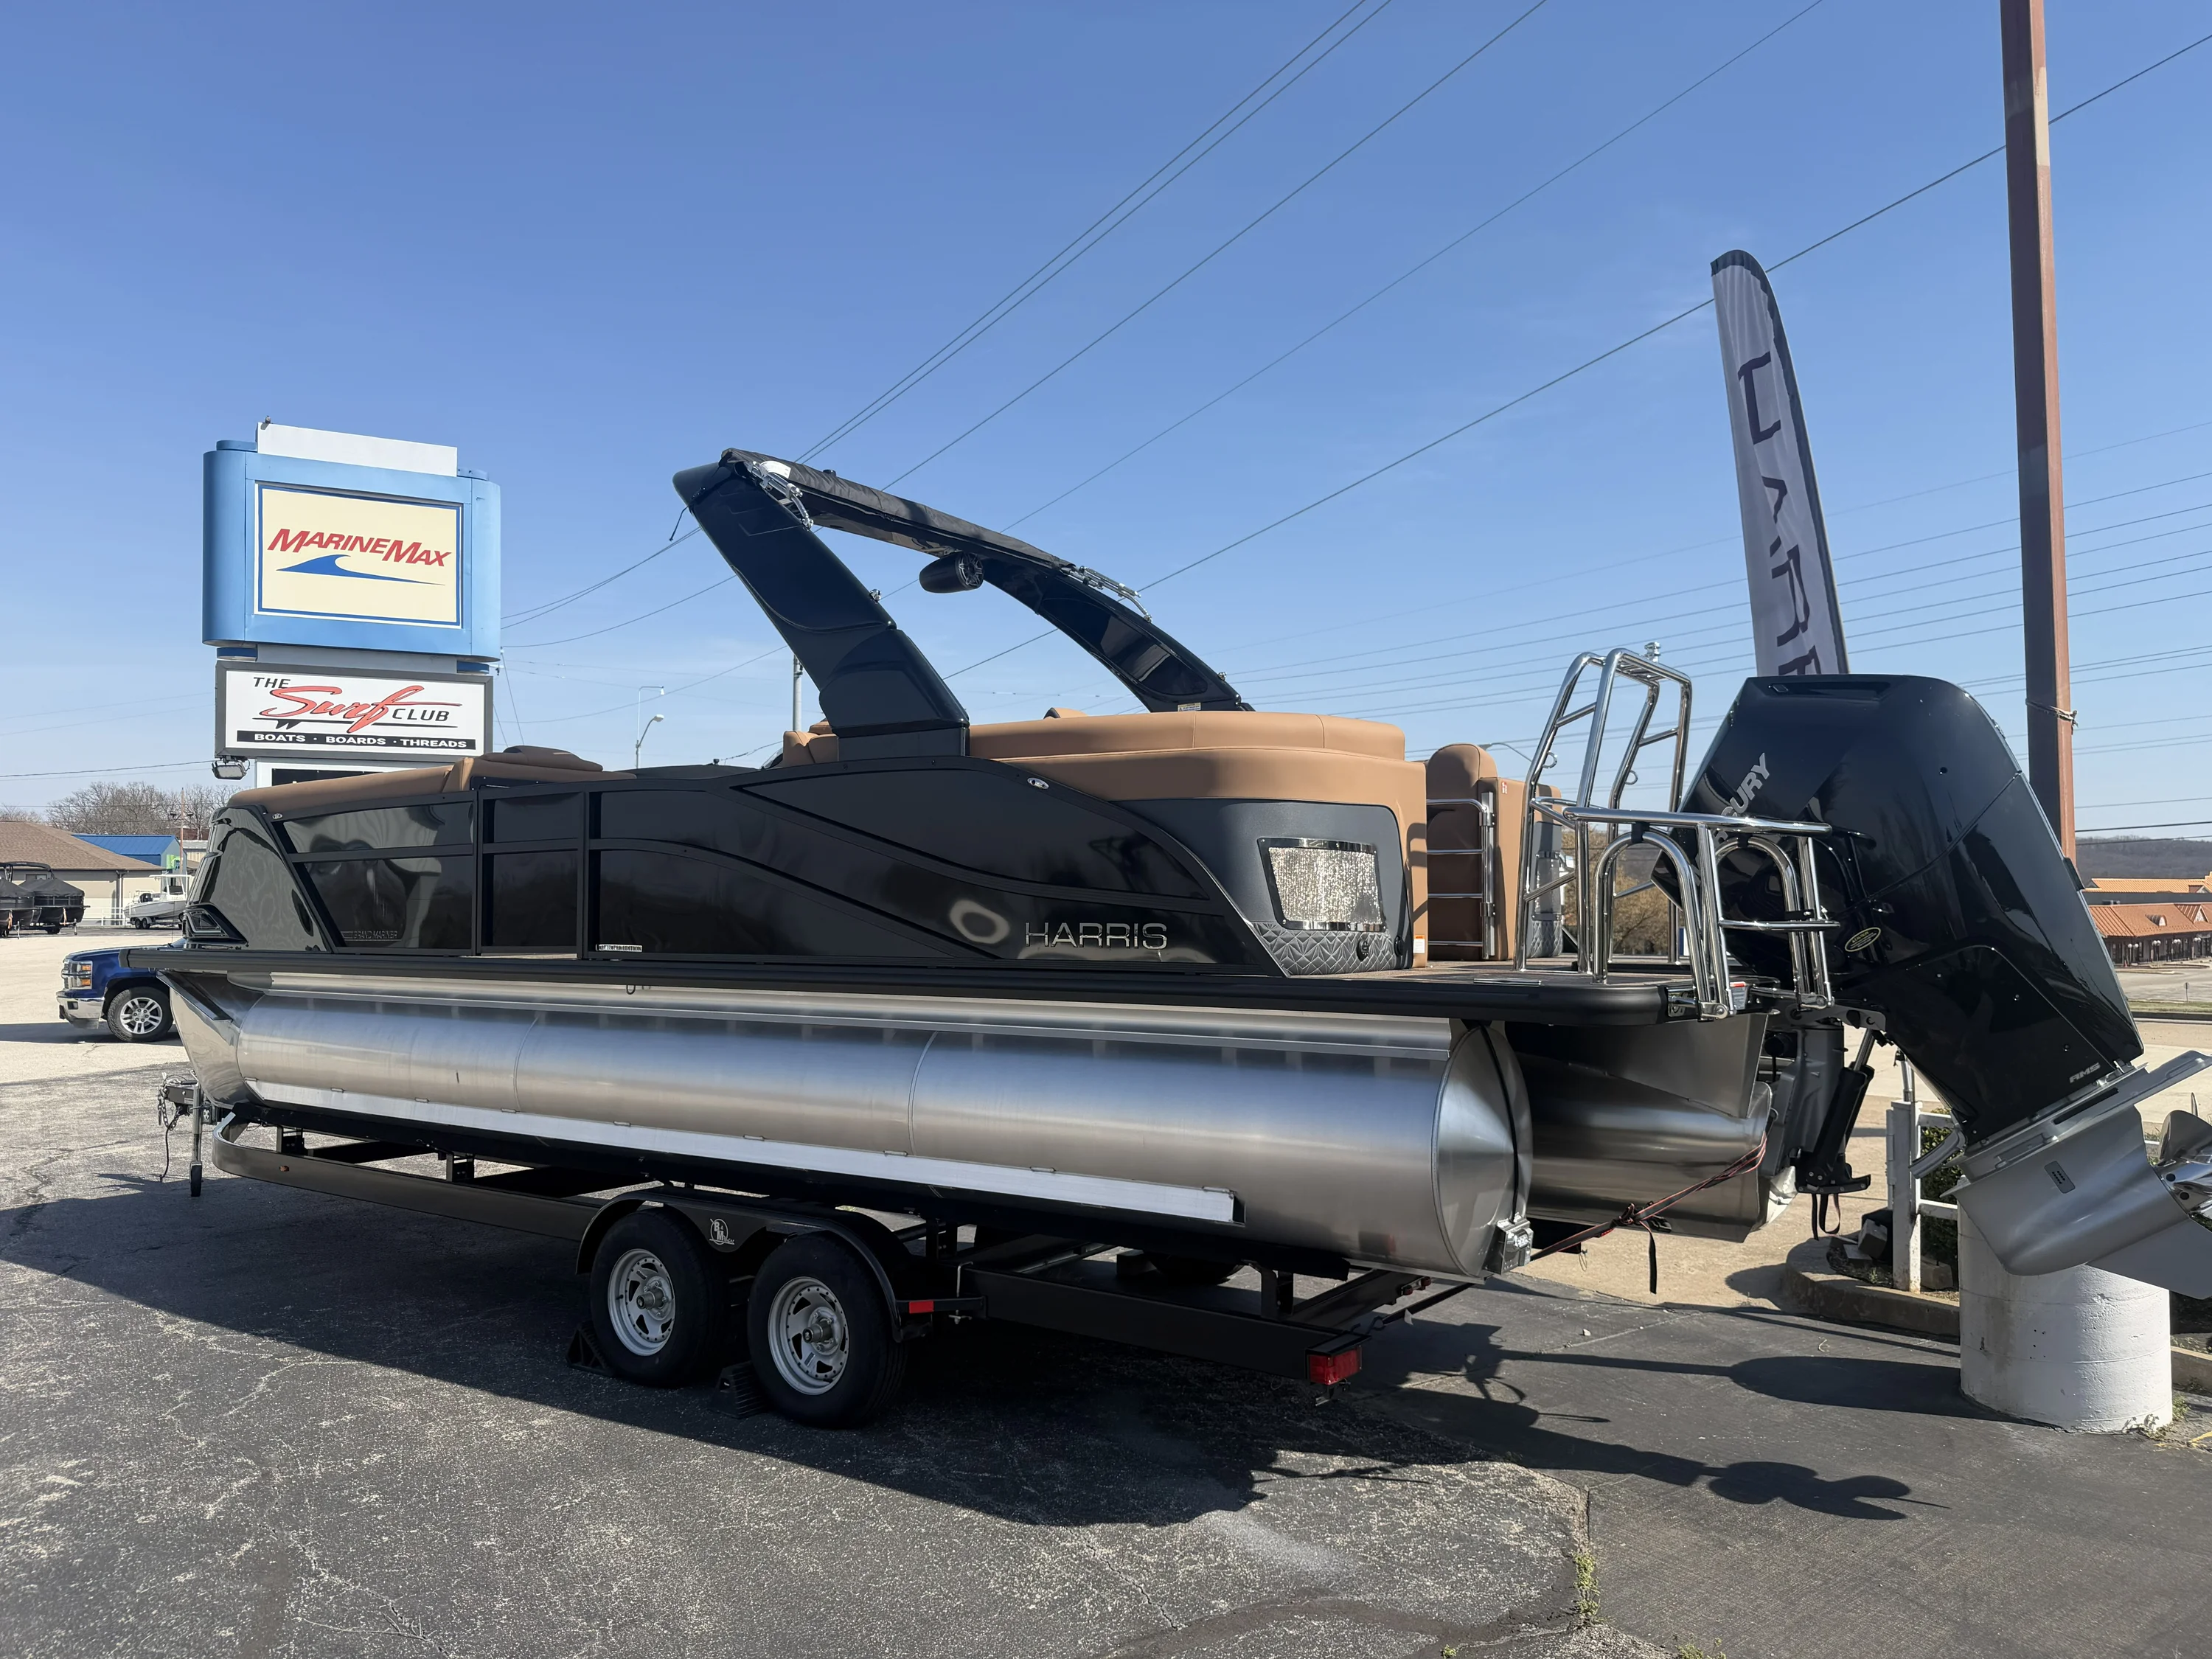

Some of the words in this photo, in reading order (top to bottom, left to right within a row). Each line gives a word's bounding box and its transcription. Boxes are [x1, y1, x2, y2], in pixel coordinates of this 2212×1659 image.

[253, 677, 291, 689] THE
[259, 685, 462, 734] Surf
[392, 708, 450, 722] CLUB
[254, 734, 306, 742] BOATS
[325, 737, 386, 745] BOARDS
[400, 739, 467, 748] THREADS
[1025, 922, 1167, 950] HARRIS
